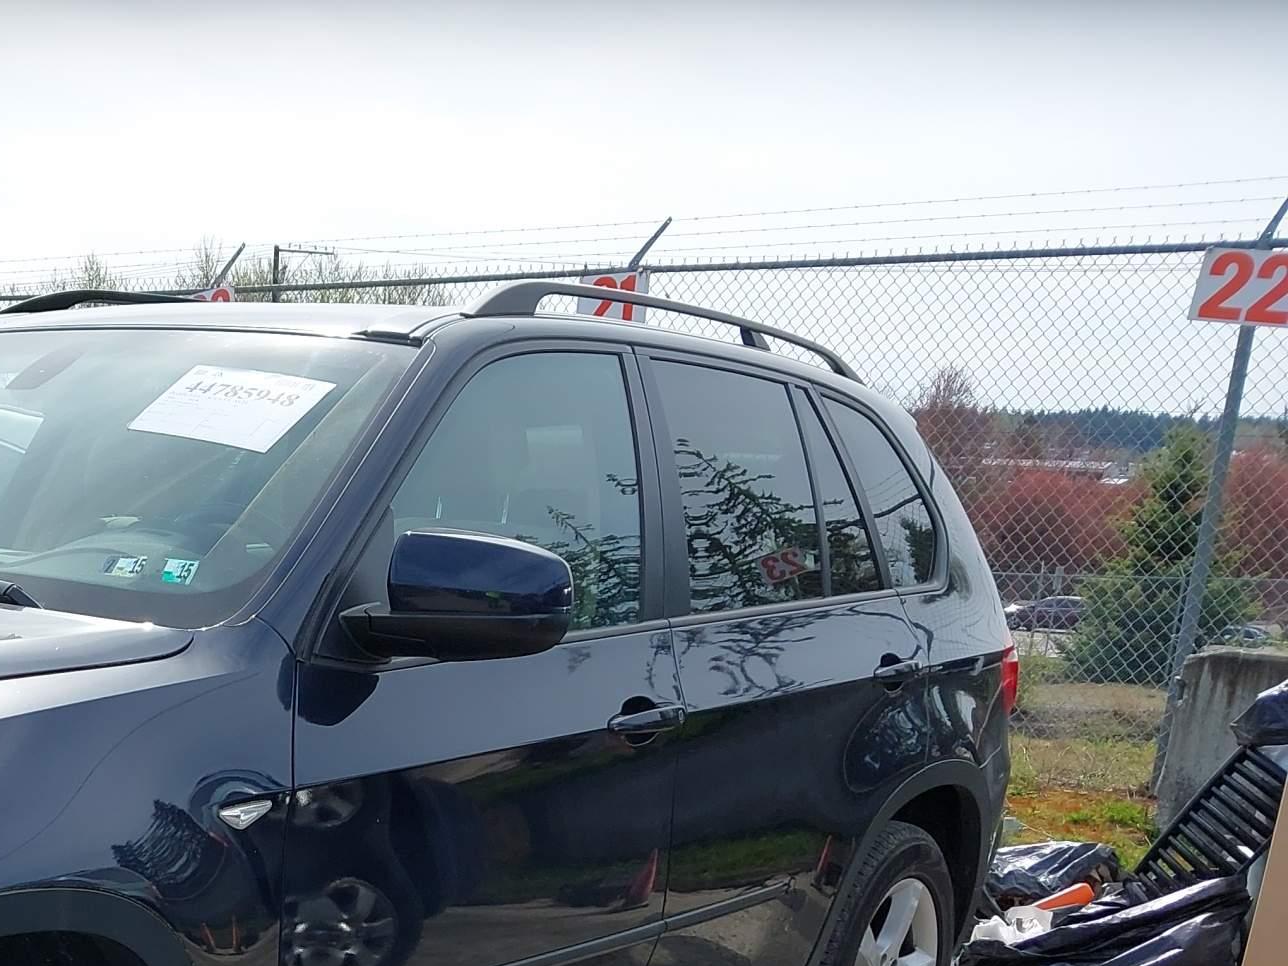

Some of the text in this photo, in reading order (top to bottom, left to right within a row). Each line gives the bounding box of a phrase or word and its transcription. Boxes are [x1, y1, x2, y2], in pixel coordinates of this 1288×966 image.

[1198, 251, 1288, 324] 22
[185, 380, 300, 407] 44785948
[176, 561, 194, 580] 15
